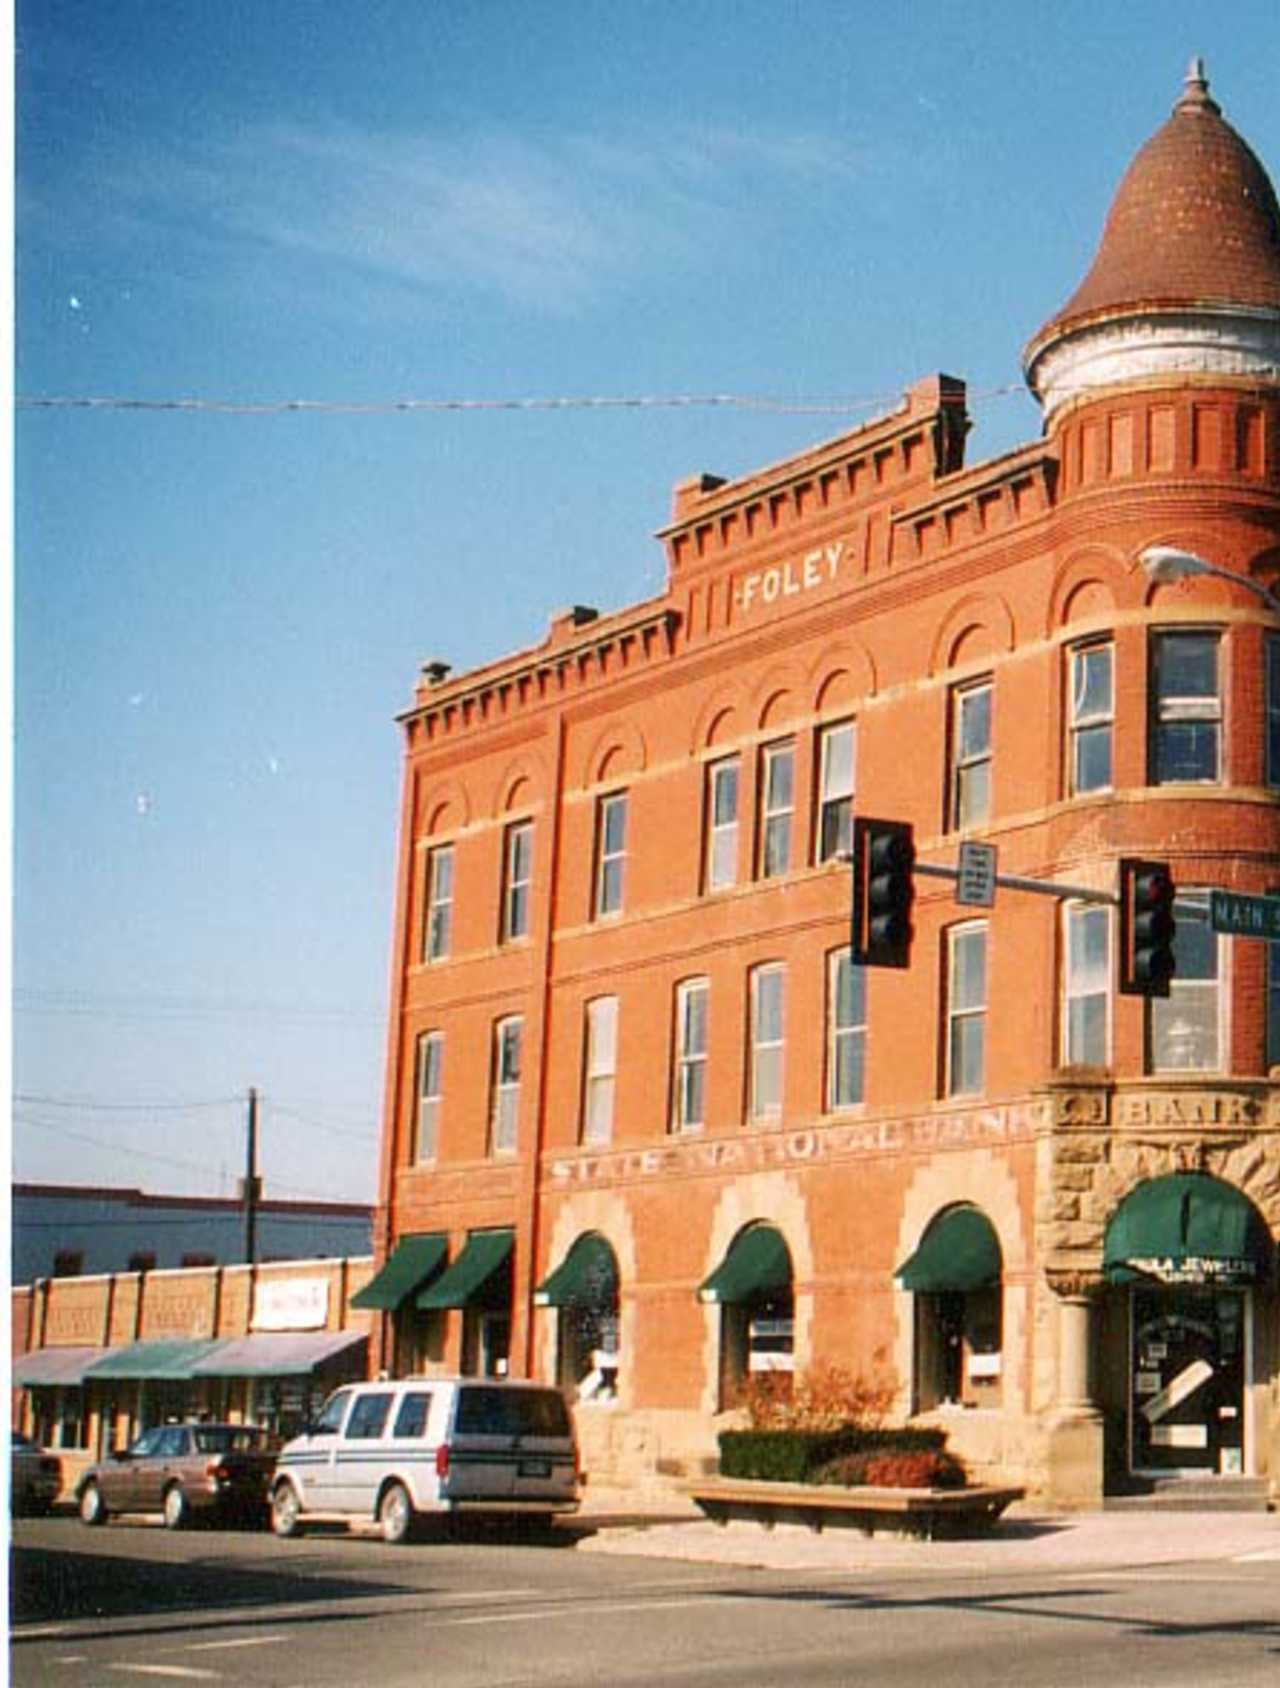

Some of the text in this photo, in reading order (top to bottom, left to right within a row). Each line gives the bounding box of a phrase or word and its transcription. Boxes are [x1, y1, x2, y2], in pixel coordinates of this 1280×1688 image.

[743, 543, 844, 610] FOLEY
[1215, 902, 1263, 930] MAIN
[1118, 1096, 1260, 1125] BANK
